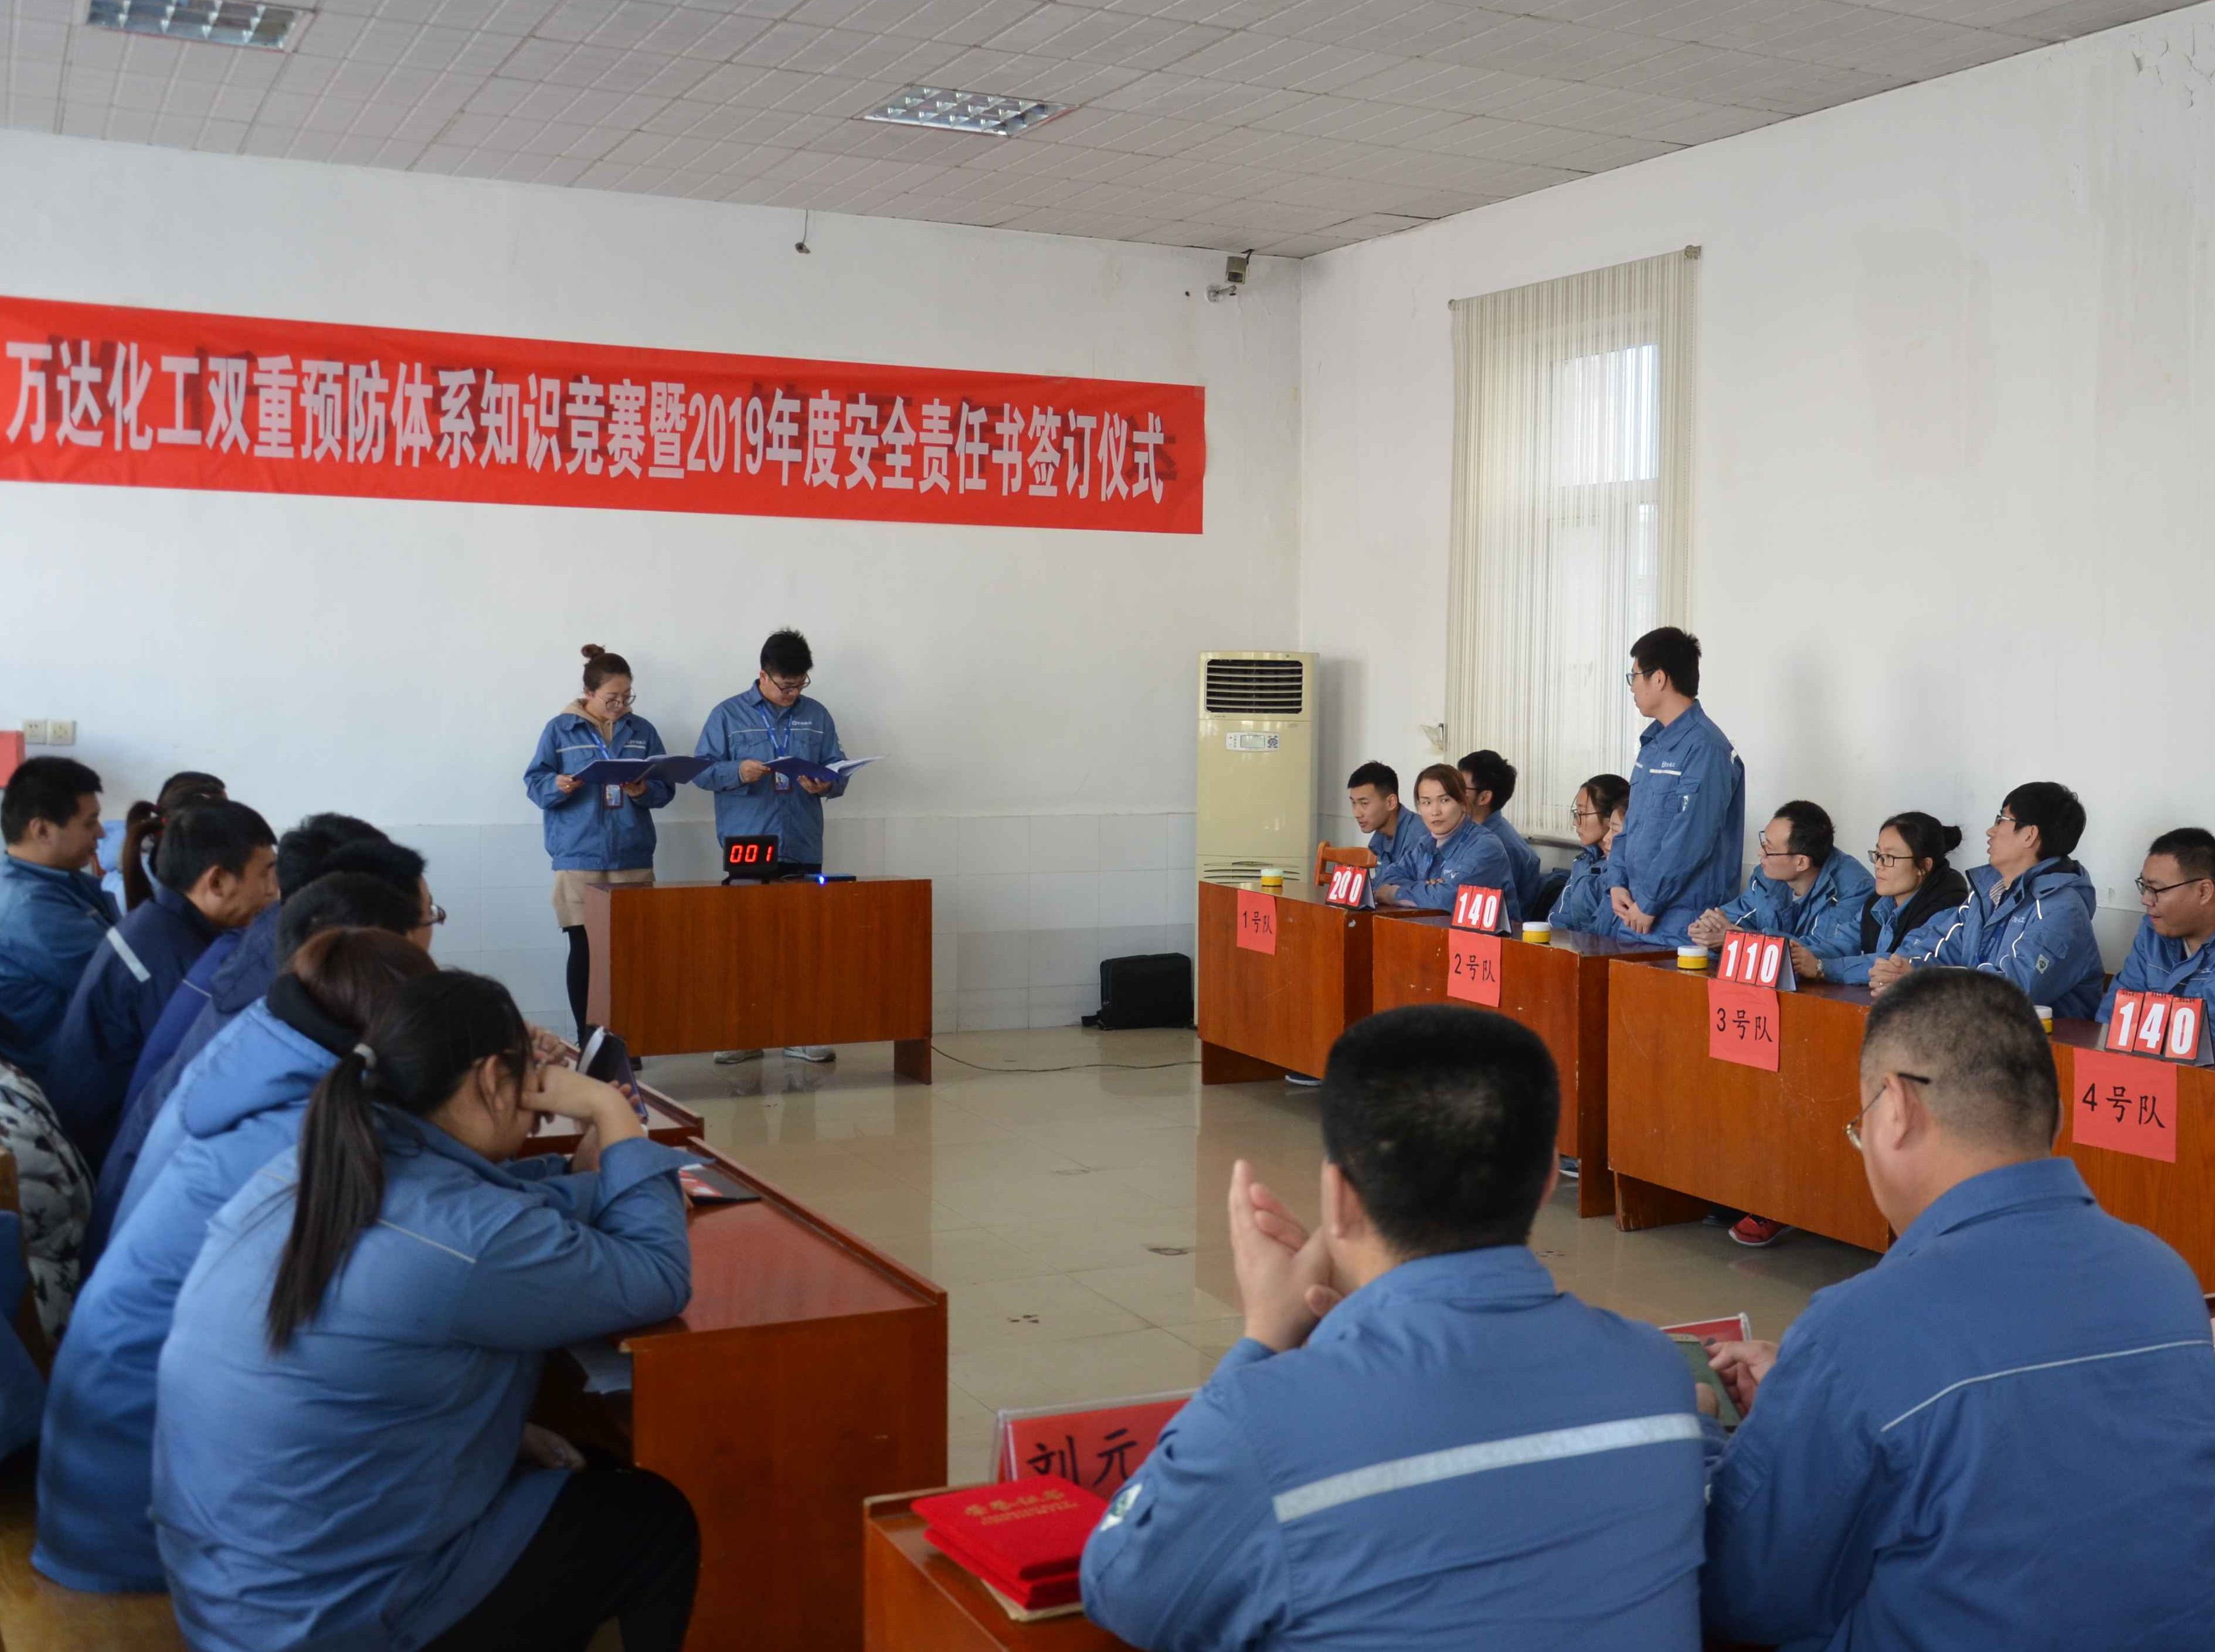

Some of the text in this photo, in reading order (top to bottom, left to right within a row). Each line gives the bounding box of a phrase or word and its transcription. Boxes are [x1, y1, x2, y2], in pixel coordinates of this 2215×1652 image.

[5, 339, 1164, 505] 万达化工双重预防体系知识竞赛暨2019年度安全责任书签订仪式
[730, 845, 773, 863] 001
[1329, 870, 1363, 903] 200
[1243, 910, 1272, 934] 1号队
[1458, 892, 1497, 928] 140
[1455, 953, 1495, 983] 2号队
[1725, 940, 1779, 983] 110
[1717, 1008, 1773, 1042] 3号队
[2119, 1001, 2195, 1055] 140
[2082, 1083, 2165, 1128] 4号队
